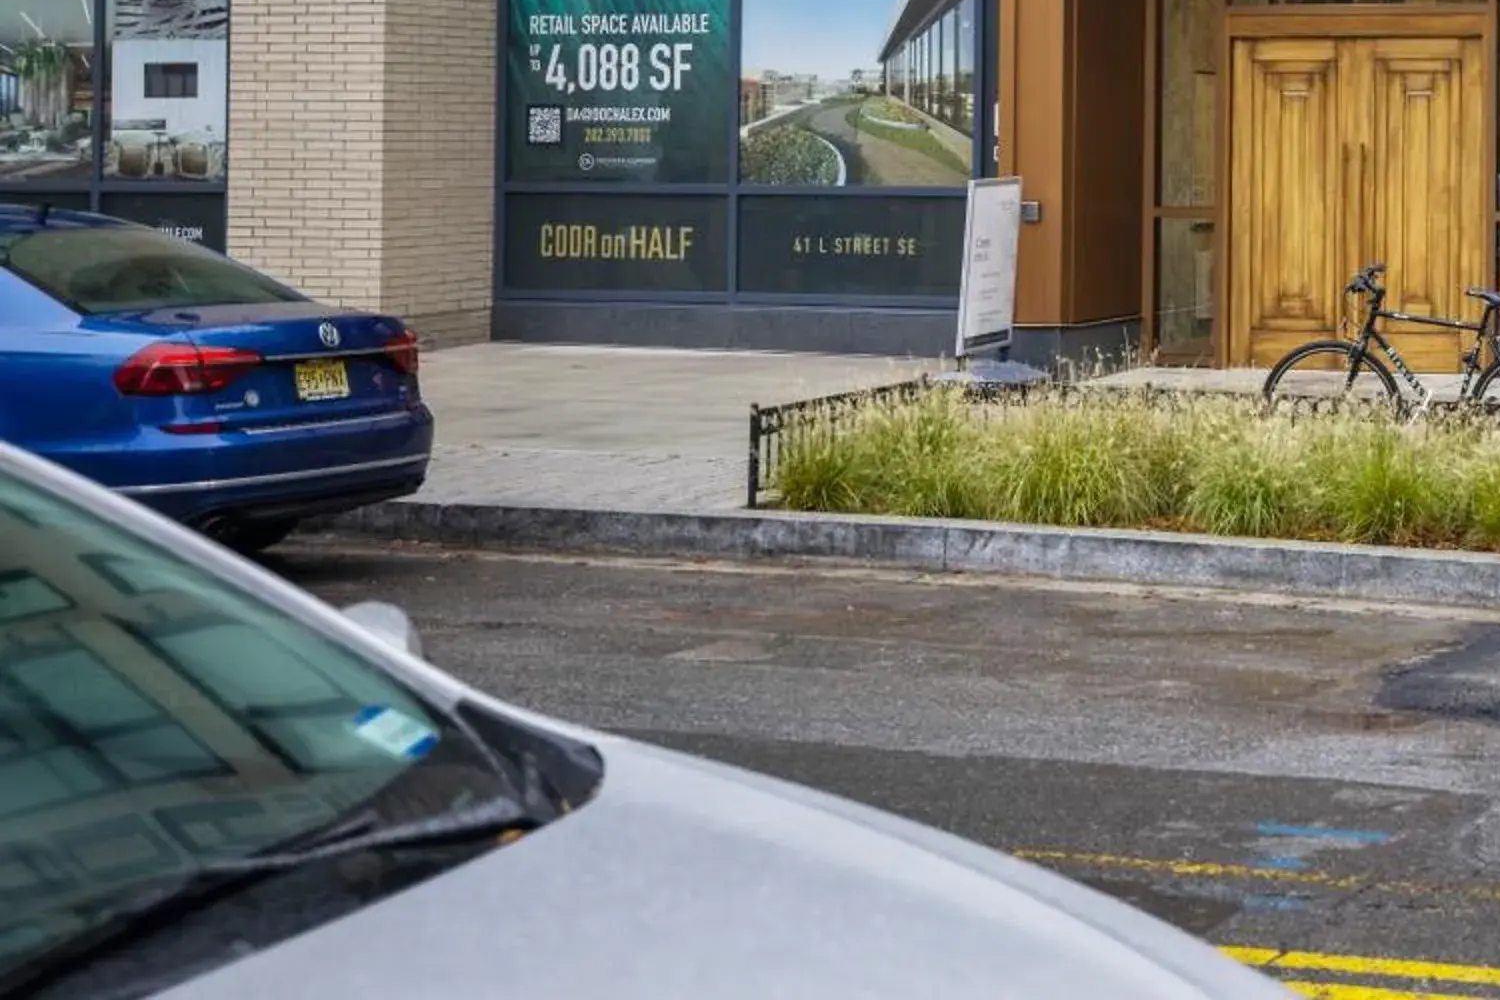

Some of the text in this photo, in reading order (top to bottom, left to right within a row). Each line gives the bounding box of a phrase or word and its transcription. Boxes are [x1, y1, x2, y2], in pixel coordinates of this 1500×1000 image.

[529, 13, 710, 35] RETAIL SPACE AVAILABLE
[529, 43, 541, 56] UP
[545, 42, 693, 95] 4,088 SF
[540, 225, 693, 260] CODA on HALF
[818, 236, 828, 254] L
[833, 236, 890, 255] STREET
[897, 237, 917, 255] SE
